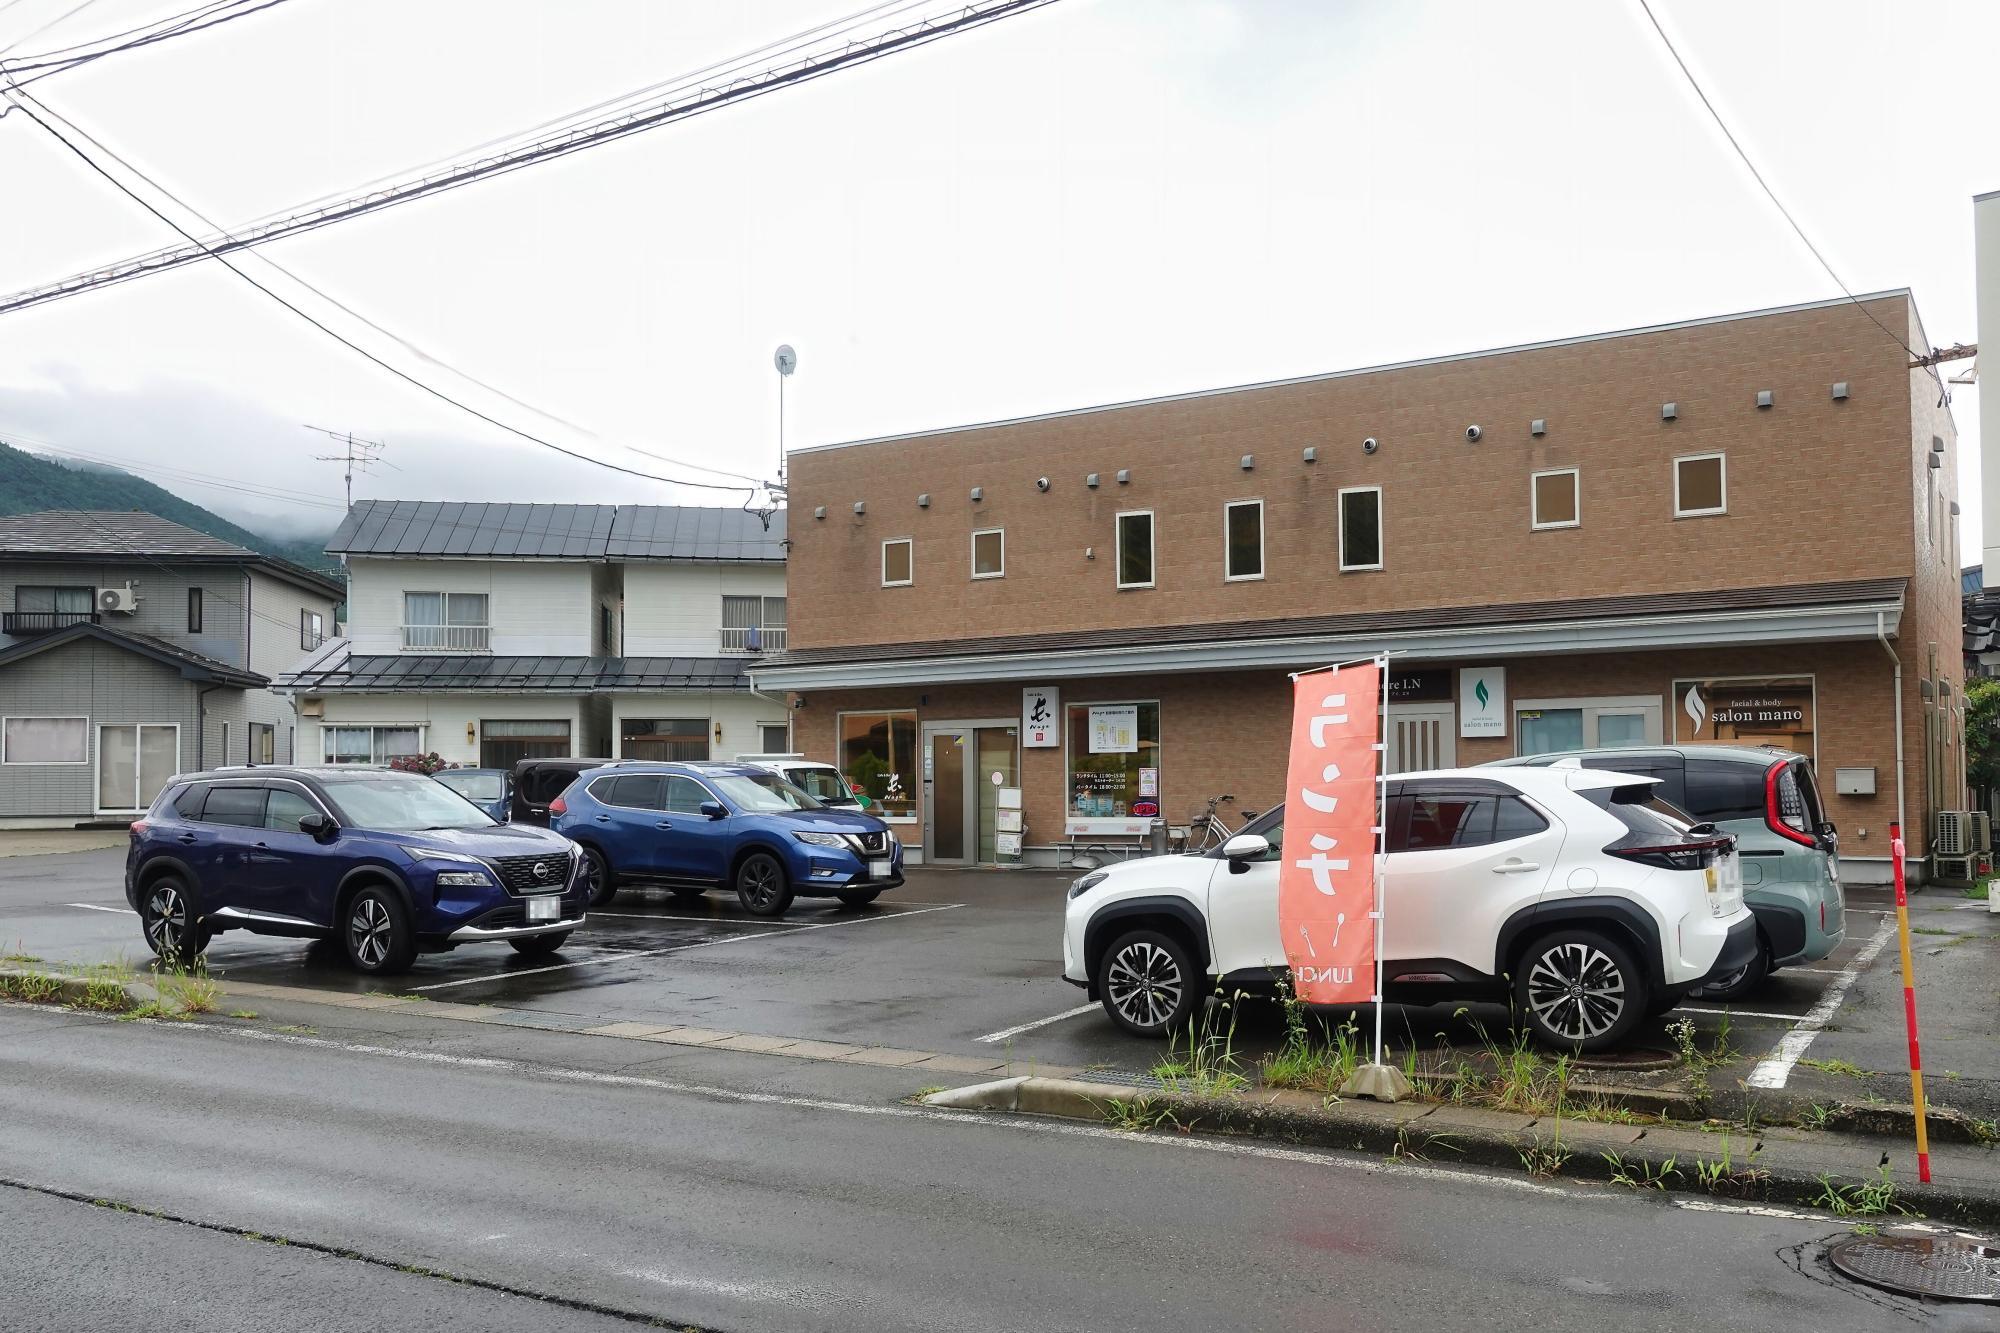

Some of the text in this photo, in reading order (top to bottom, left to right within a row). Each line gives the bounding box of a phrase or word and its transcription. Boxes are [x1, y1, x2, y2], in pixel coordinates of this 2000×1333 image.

[1762, 699, 1782, 707] body
[1712, 709, 1803, 722] salon mano
[1133, 804, 1158, 813] OPEN
